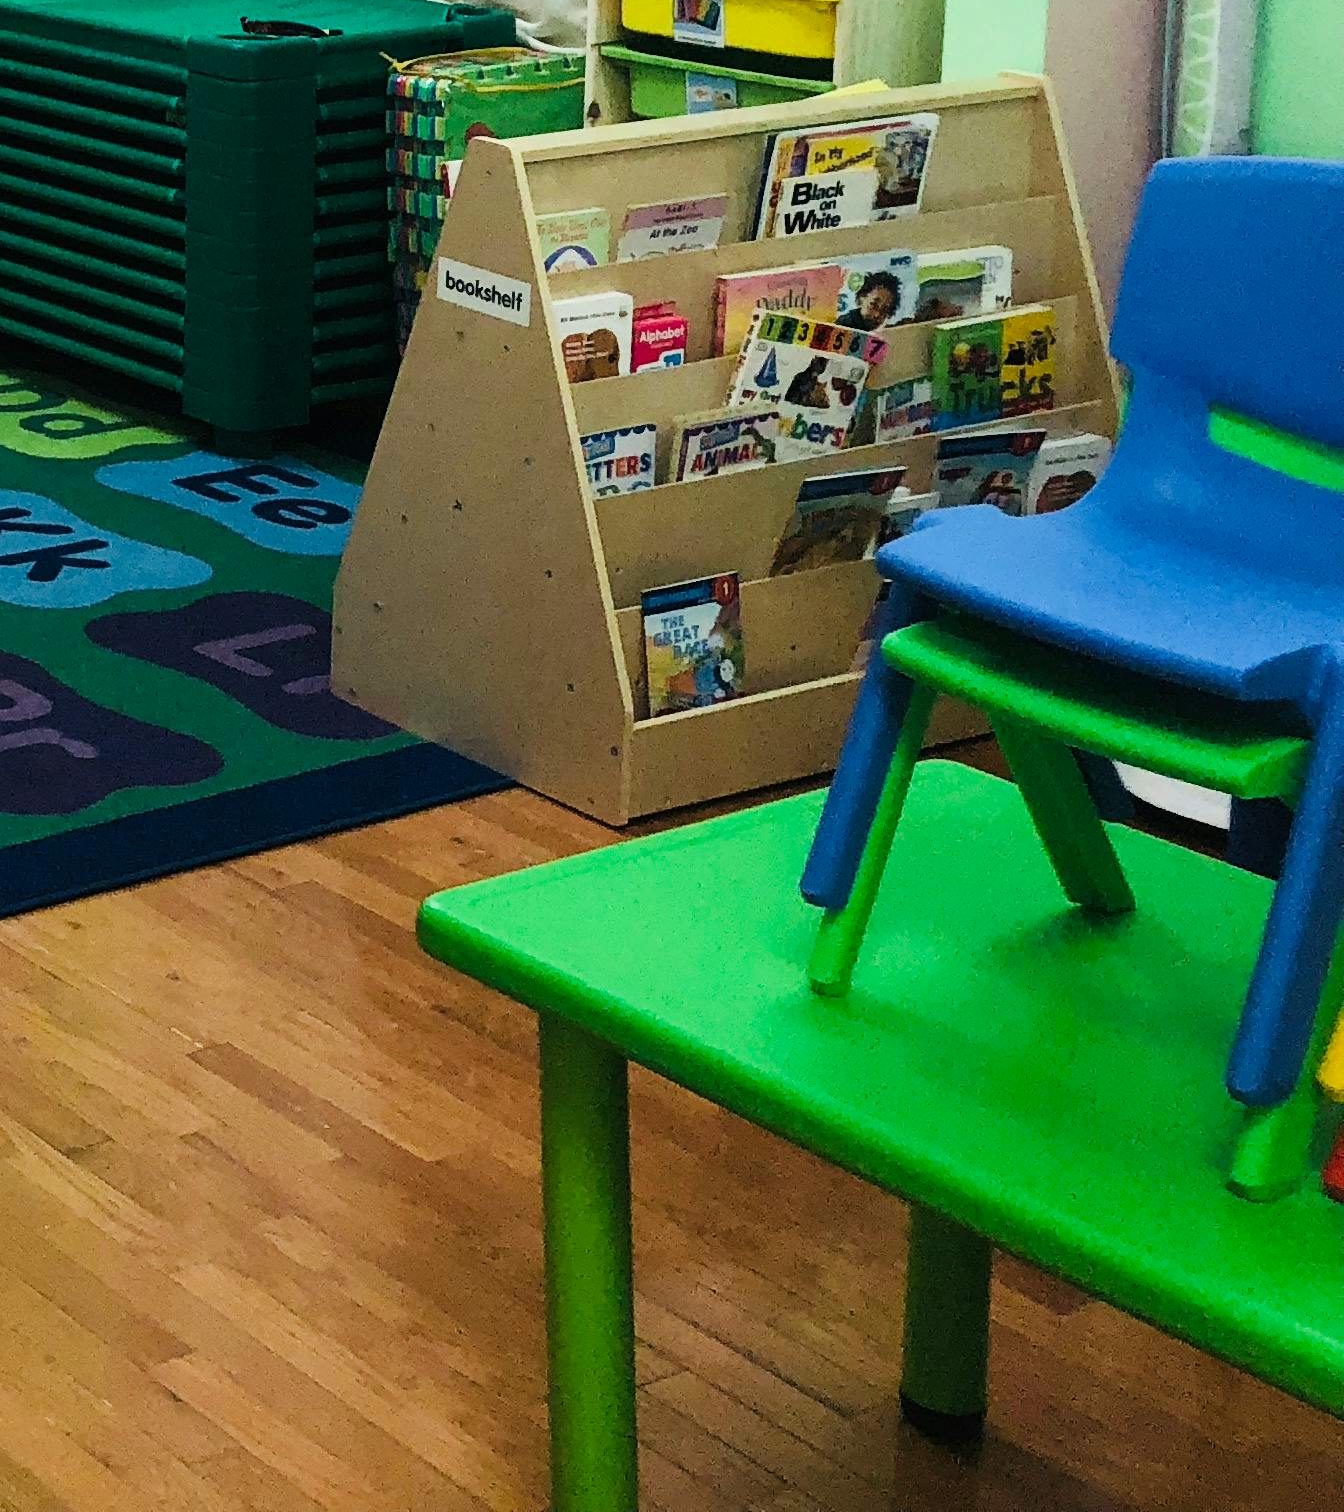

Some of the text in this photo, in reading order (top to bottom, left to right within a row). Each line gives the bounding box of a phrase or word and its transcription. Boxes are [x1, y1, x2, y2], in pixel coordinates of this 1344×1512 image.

[791, 181, 845, 206] Black
[819, 199, 837, 210] on
[784, 209, 842, 234] White
[445, 270, 523, 312] bookshelf
[639, 325, 686, 344] Alphabet
[797, 322, 810, 341] 3
[869, 339, 885, 358] 7
[171, 464, 352, 530] Ee
[661, 615, 685, 629] THE
